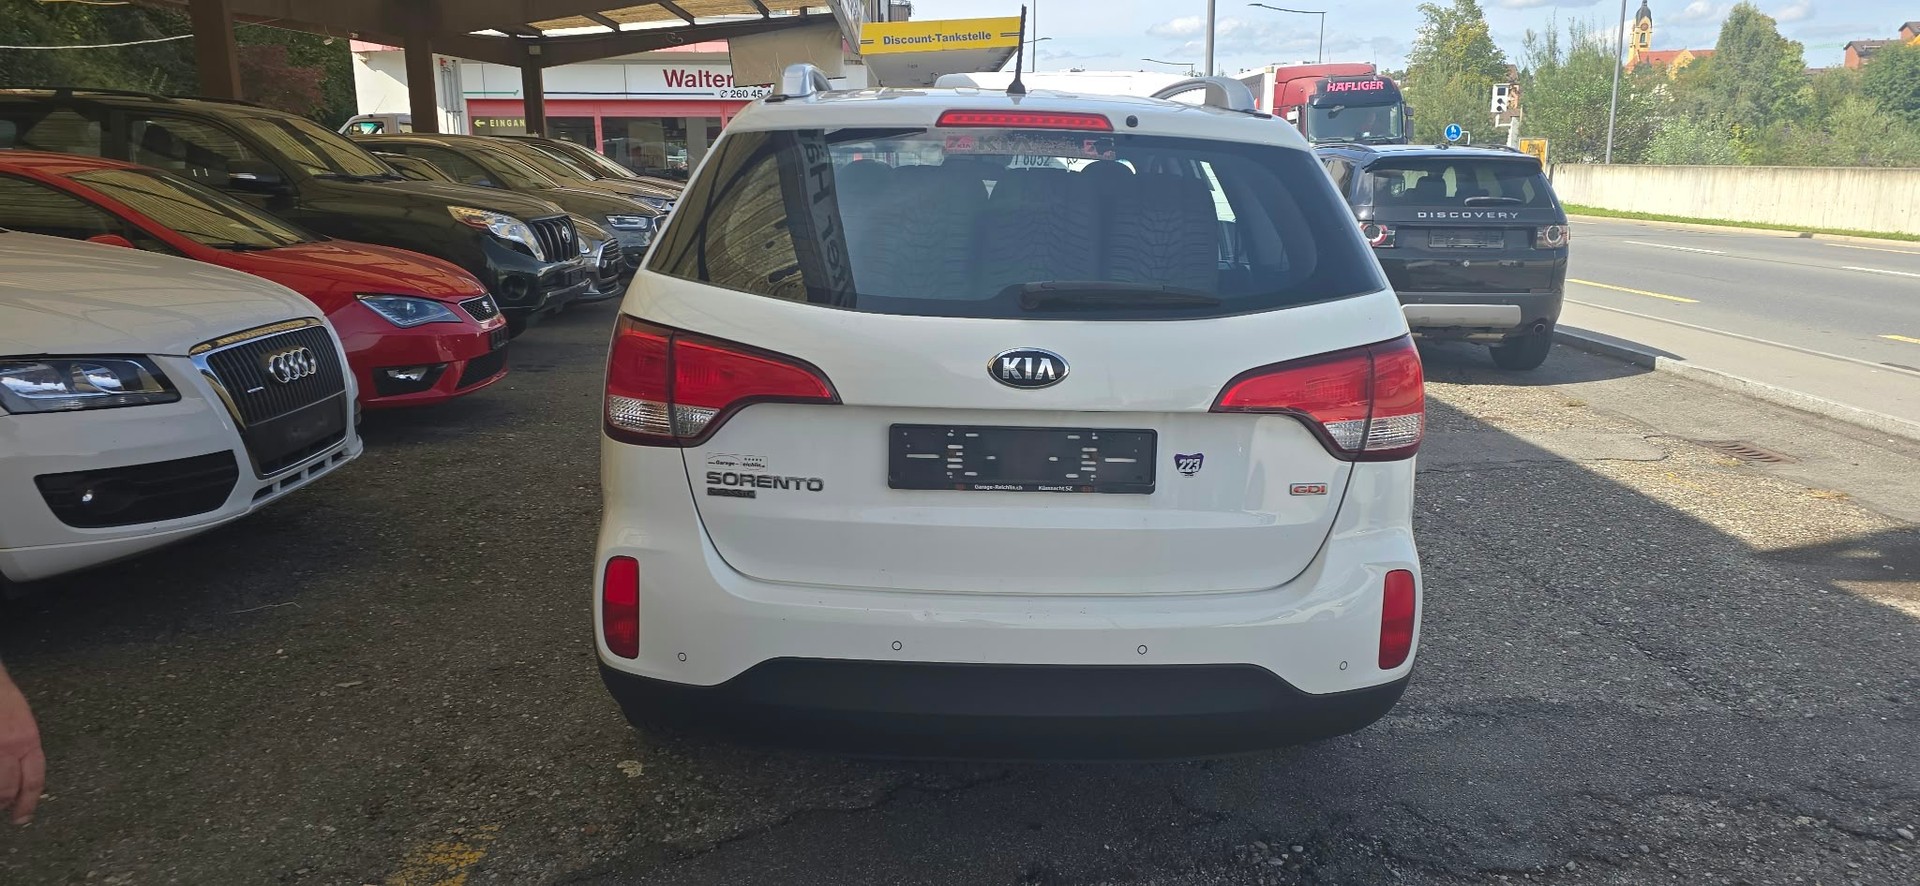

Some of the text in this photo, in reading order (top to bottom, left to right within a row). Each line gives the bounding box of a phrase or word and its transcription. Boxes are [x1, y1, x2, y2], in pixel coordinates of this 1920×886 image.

[883, 31, 992, 46] Discount-Tankstelle
[662, 69, 734, 88] Walter
[730, 90, 748, 98] 260
[751, 90, 763, 98] 45
[489, 119, 526, 127] EINGAN
[1002, 357, 1056, 380] KIA
[1179, 458, 1201, 472] 223
[706, 471, 824, 492] SORENTO
[1293, 485, 1326, 494] GDI
